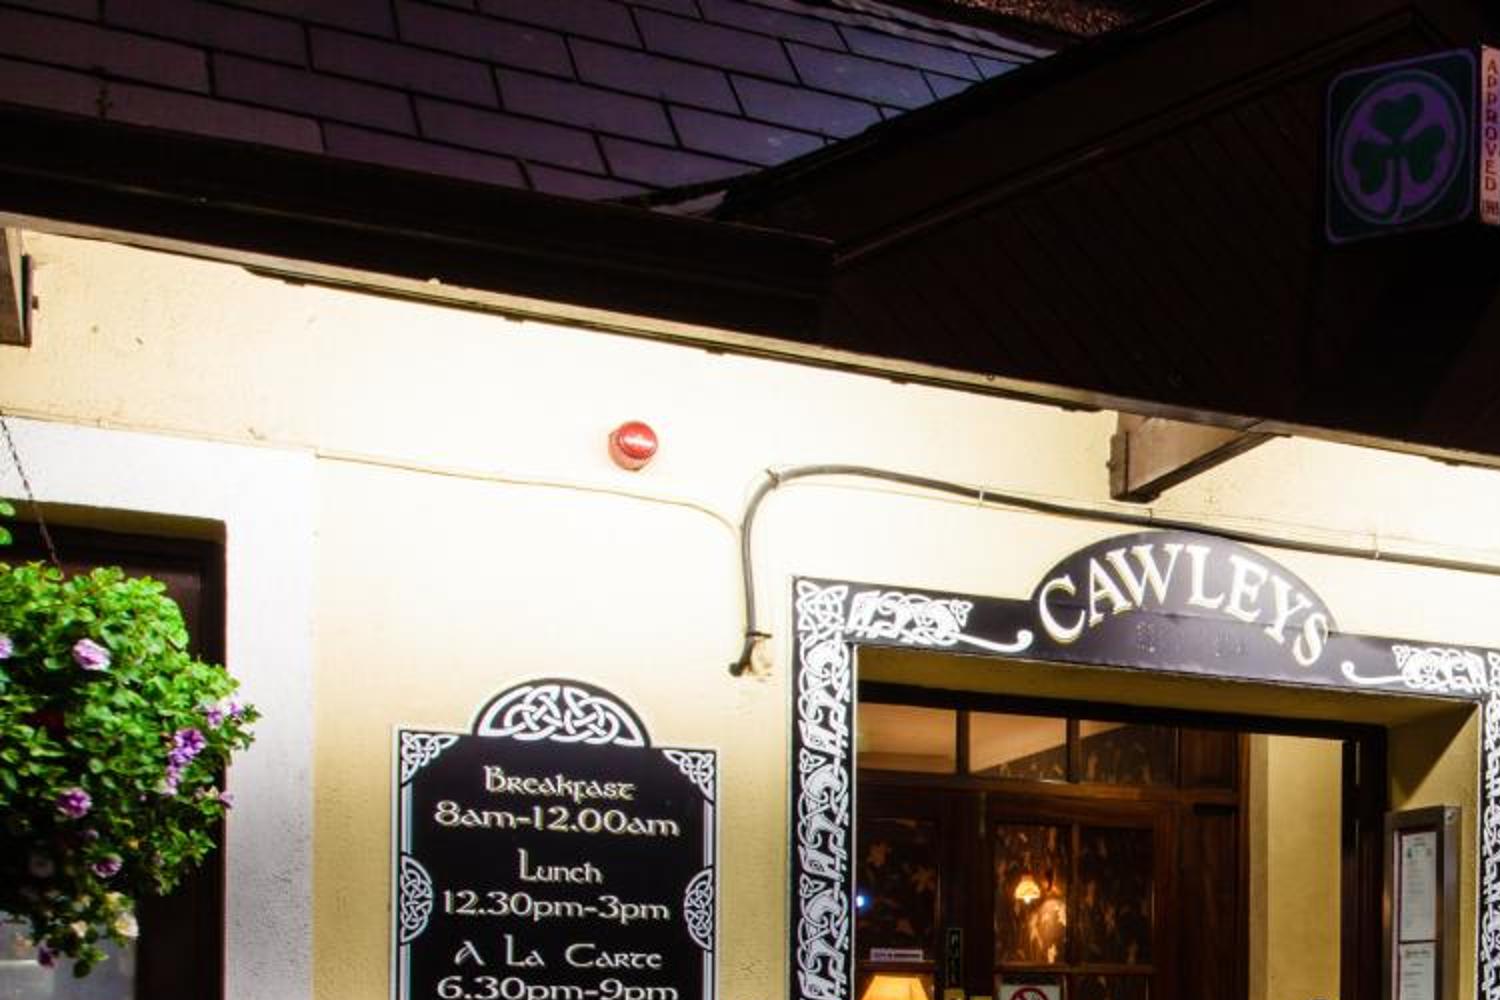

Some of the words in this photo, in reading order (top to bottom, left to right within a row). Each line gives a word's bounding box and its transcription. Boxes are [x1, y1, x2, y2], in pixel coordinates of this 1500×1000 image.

[1485, 59, 1498, 192] APPROVED
[1038, 543, 1329, 667] CAWLEYS
[484, 766, 635, 801] Breakfast
[433, 800, 680, 837] 8am-12.00am
[518, 848, 602, 883] Lunch
[443, 890, 670, 925] 12.30pm-3pm
[454, 940, 484, 967] A
[503, 934, 545, 967] La
[564, 943, 663, 969] Carte
